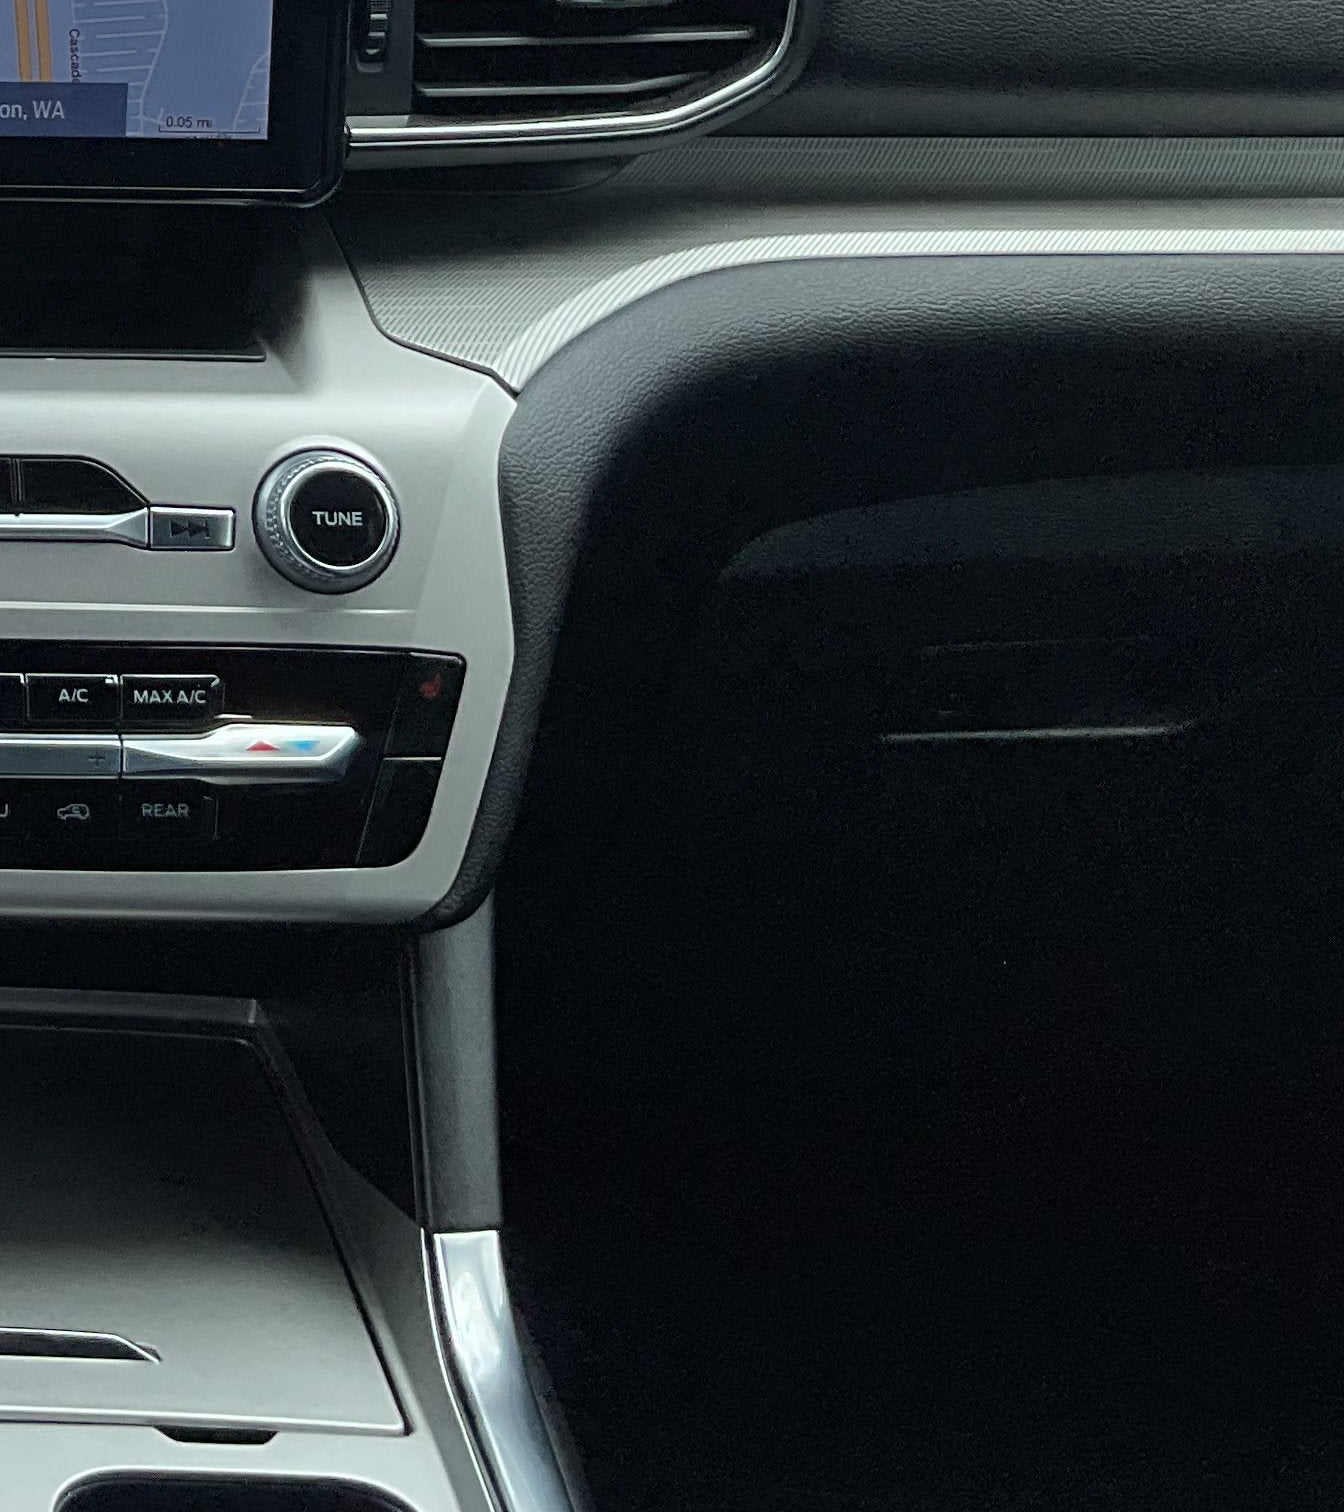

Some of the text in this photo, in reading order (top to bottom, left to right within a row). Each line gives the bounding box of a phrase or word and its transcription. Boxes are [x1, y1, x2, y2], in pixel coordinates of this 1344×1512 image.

[32, 100, 66, 120] WA
[166, 116, 193, 128] 0.05
[312, 510, 363, 527] TUNE
[58, 687, 89, 704] A/C
[133, 688, 206, 705] MAX A/C
[142, 803, 189, 819] REAR
